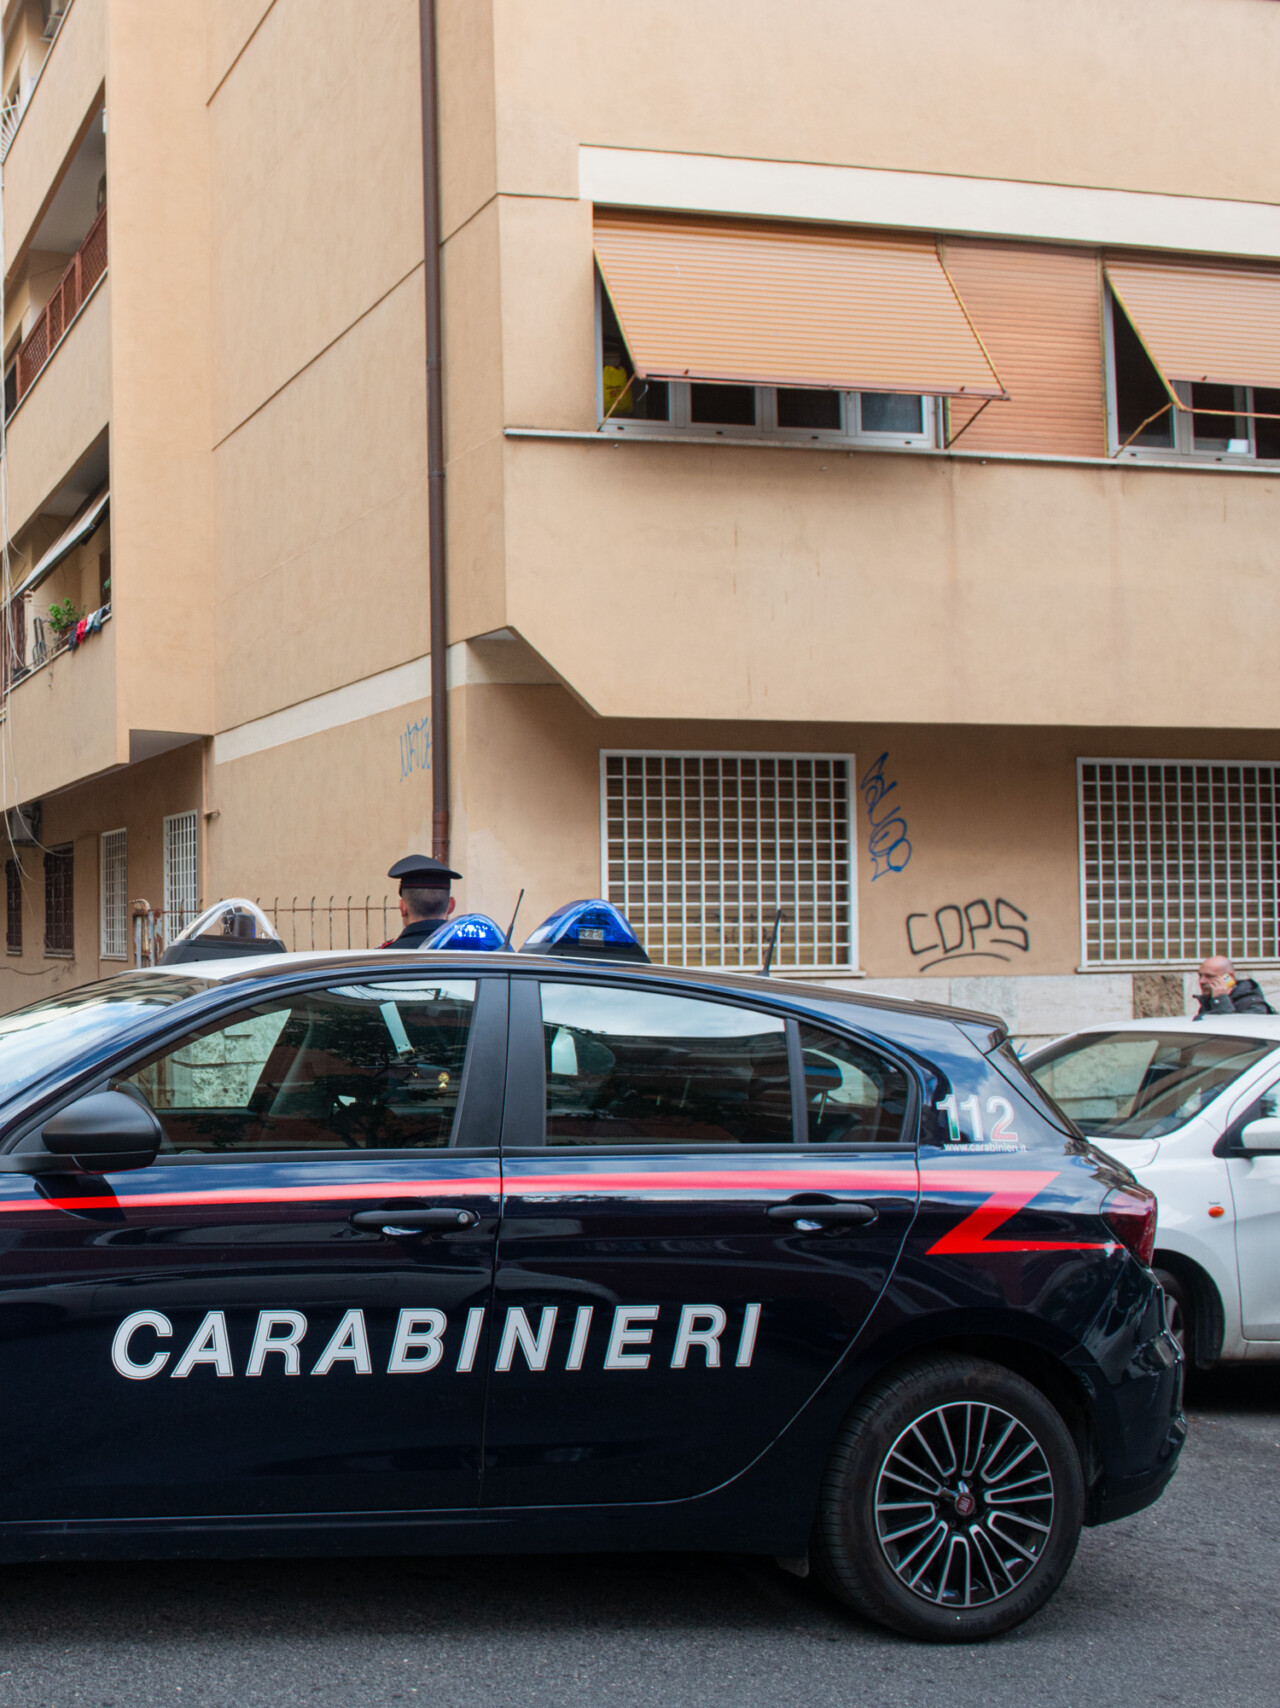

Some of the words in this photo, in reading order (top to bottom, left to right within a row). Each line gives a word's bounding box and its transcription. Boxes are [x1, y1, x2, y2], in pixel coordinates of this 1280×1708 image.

[905, 896, 1030, 957] COPS
[935, 1093, 1019, 1142] 112
[942, 1142, 1028, 1153] www.carabinieri.it
[111, 1303, 762, 1380] CARABINIERI
